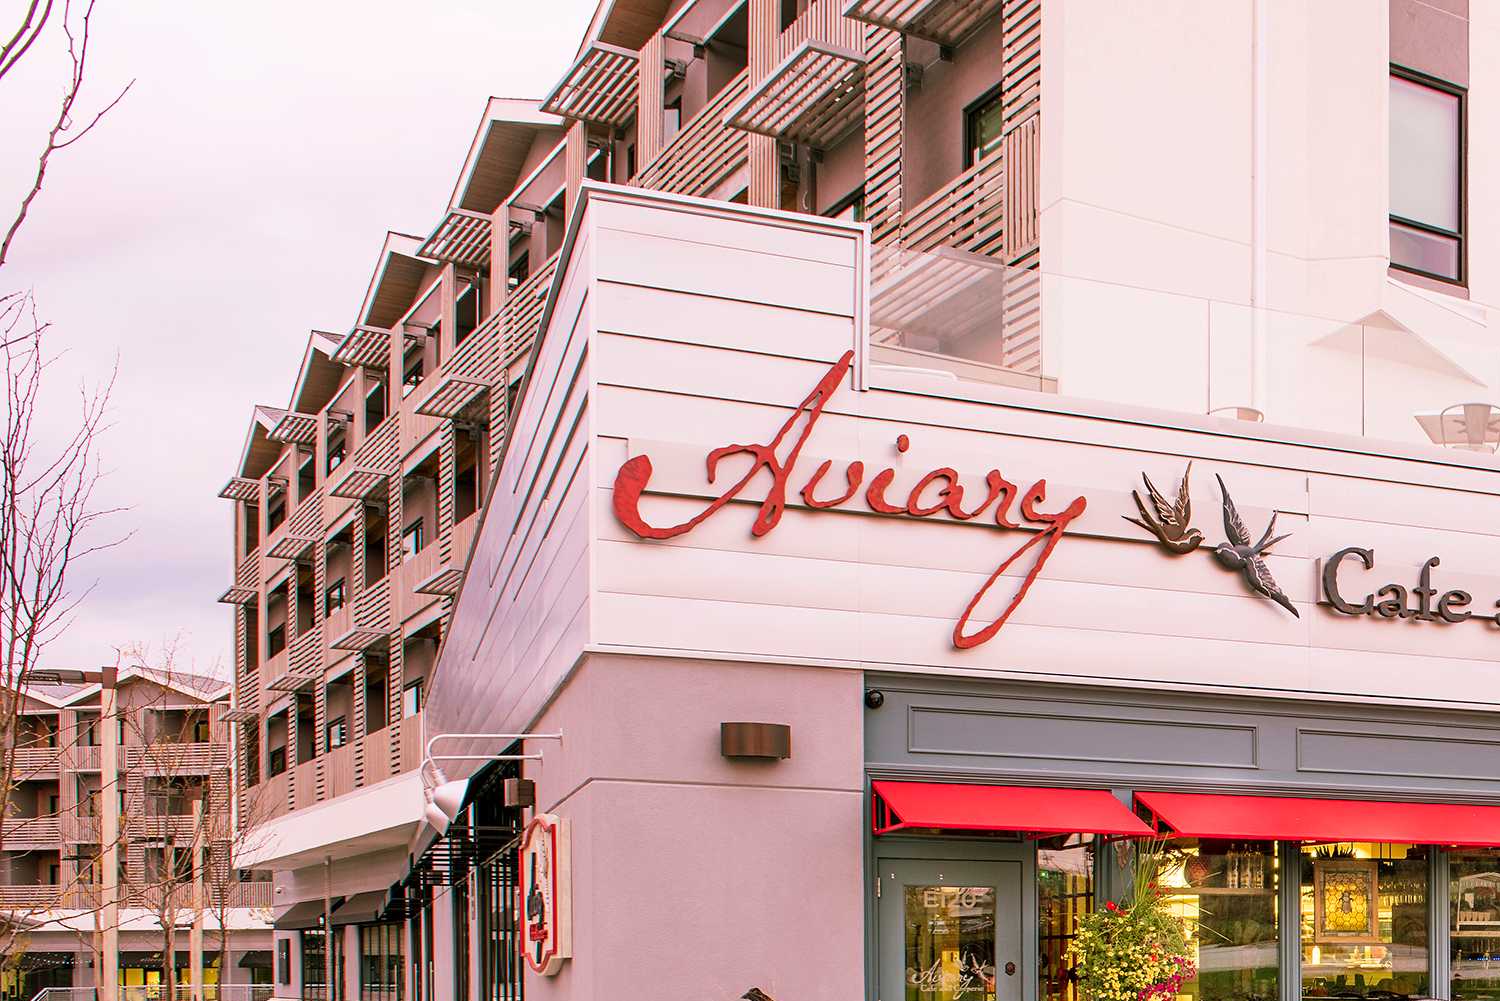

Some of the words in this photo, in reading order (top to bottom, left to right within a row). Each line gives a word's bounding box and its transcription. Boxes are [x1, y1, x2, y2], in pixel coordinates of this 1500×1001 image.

[612, 349, 1088, 651] Aviary
[1322, 546, 1473, 623] Cafe
[911, 957, 974, 1000] Avry
